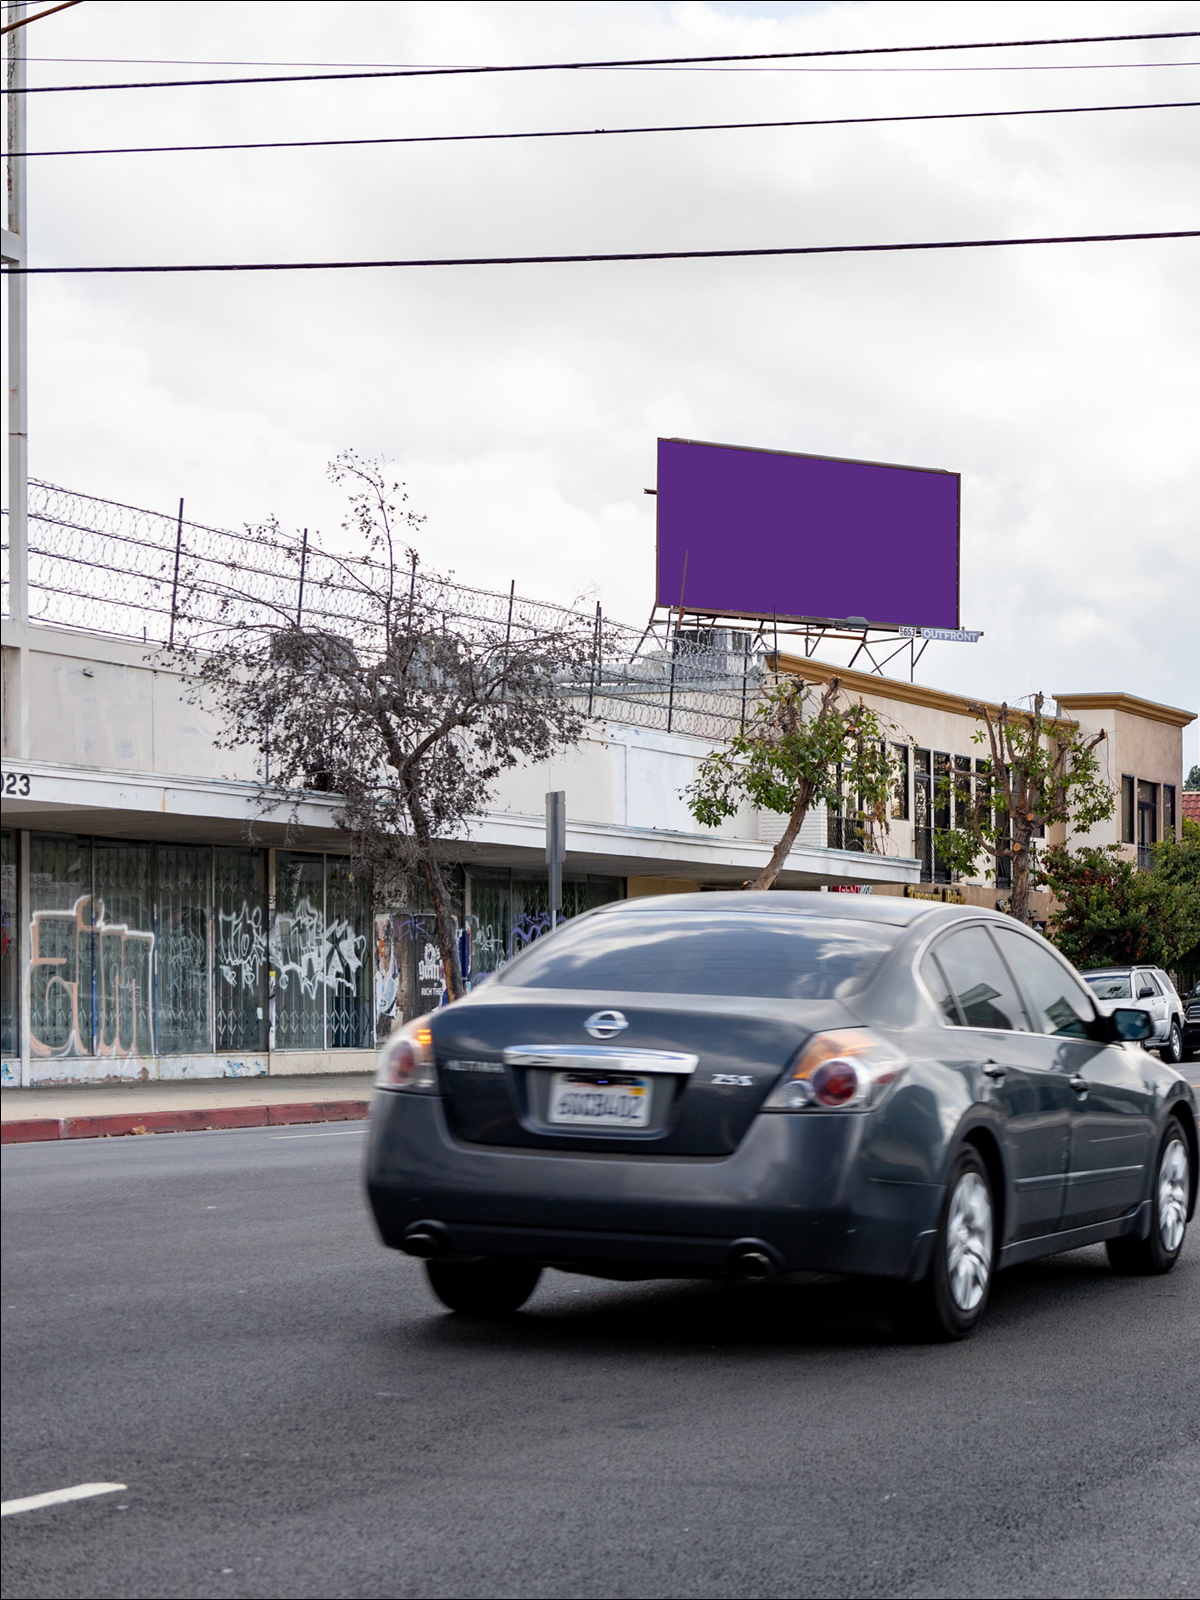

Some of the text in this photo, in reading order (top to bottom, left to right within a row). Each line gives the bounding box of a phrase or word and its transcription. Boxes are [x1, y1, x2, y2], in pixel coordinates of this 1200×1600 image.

[899, 627, 916, 637] 5653
[923, 629, 978, 641] OUTFRONT
[420, 987, 442, 996] RICH THE
